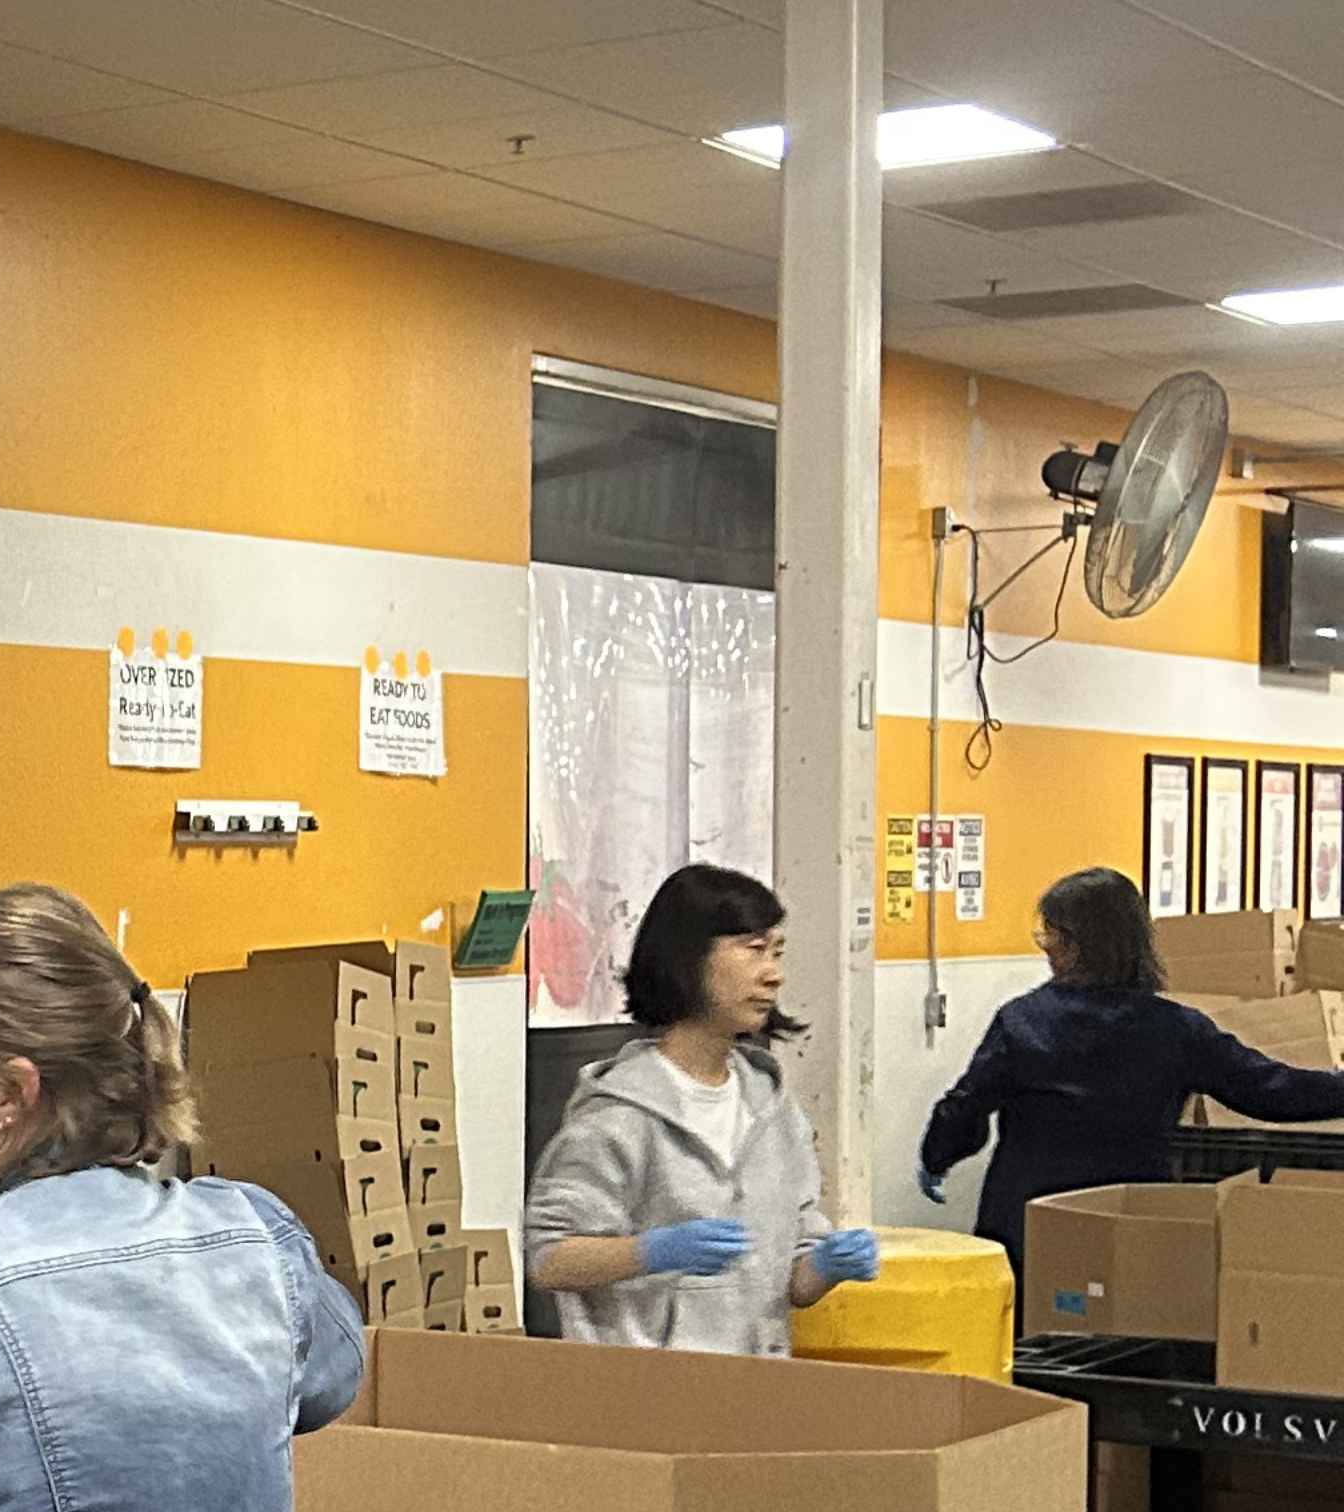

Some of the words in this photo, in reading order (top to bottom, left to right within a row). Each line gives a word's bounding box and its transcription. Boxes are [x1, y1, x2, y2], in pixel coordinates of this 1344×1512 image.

[120, 663, 195, 688] OVERIZED
[373, 678, 409, 699] READY
[370, 706, 392, 726] EAT
